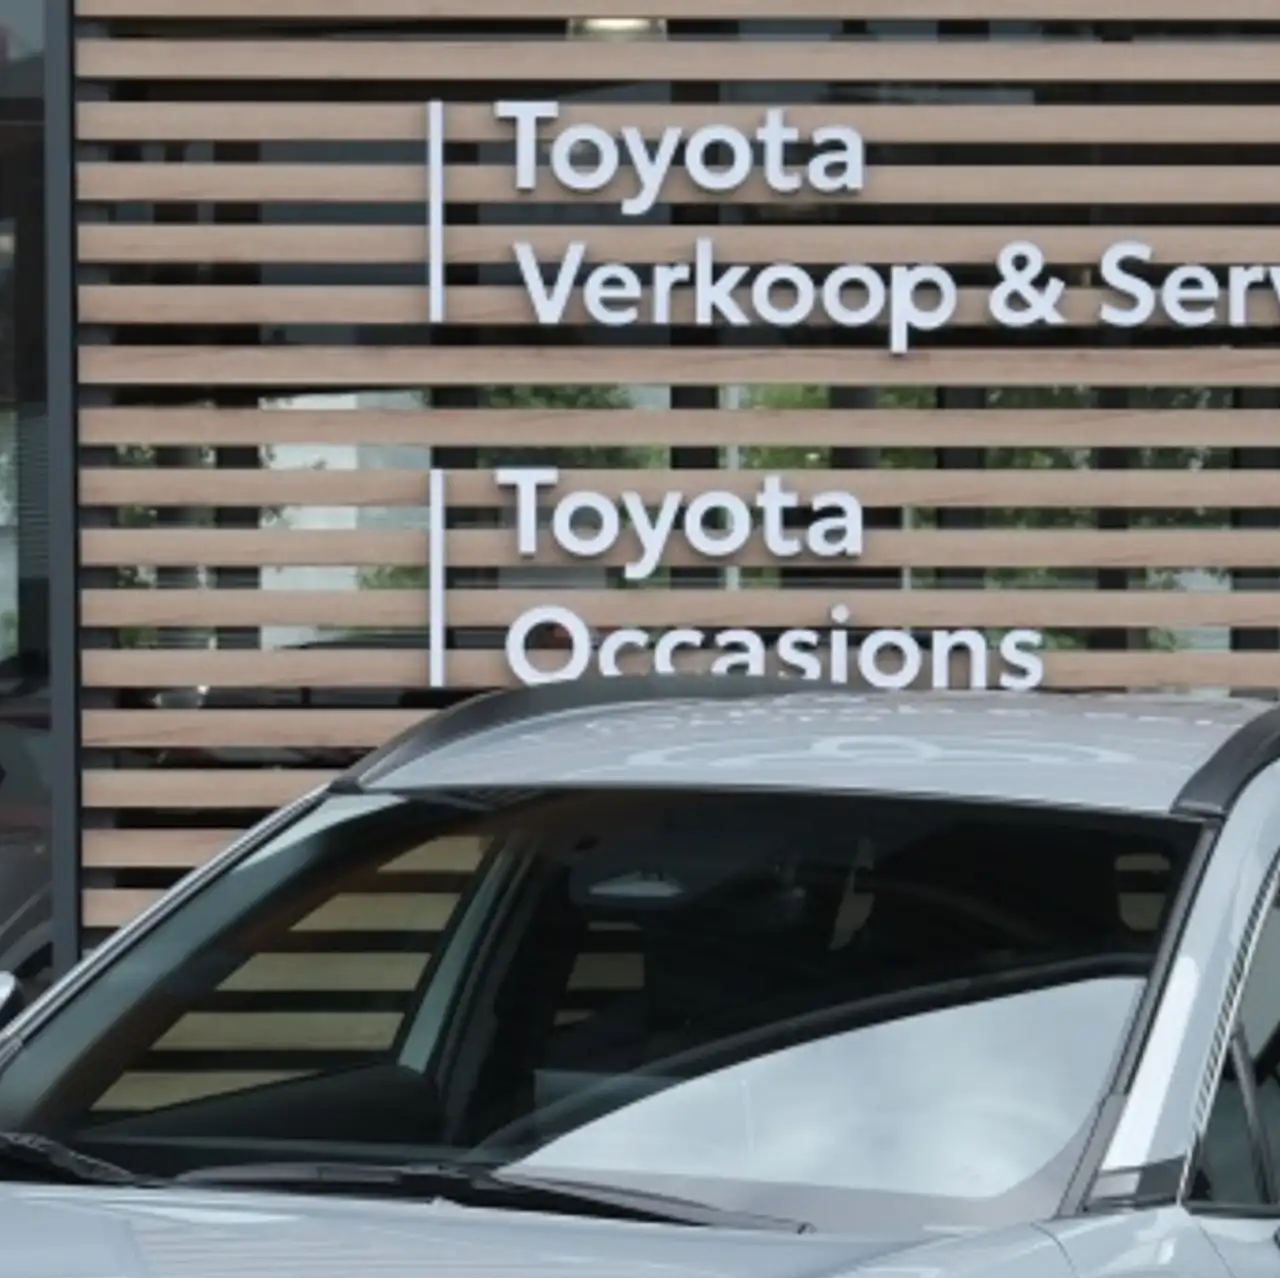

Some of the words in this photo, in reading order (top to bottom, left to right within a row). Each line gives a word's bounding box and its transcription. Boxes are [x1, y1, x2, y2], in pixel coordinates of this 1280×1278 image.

[494, 101, 864, 216] Toyota
[513, 236, 957, 353] Verkoop
[989, 241, 1067, 326] &
[495, 467, 864, 580] Toyota
[505, 604, 1044, 690] Occasions
